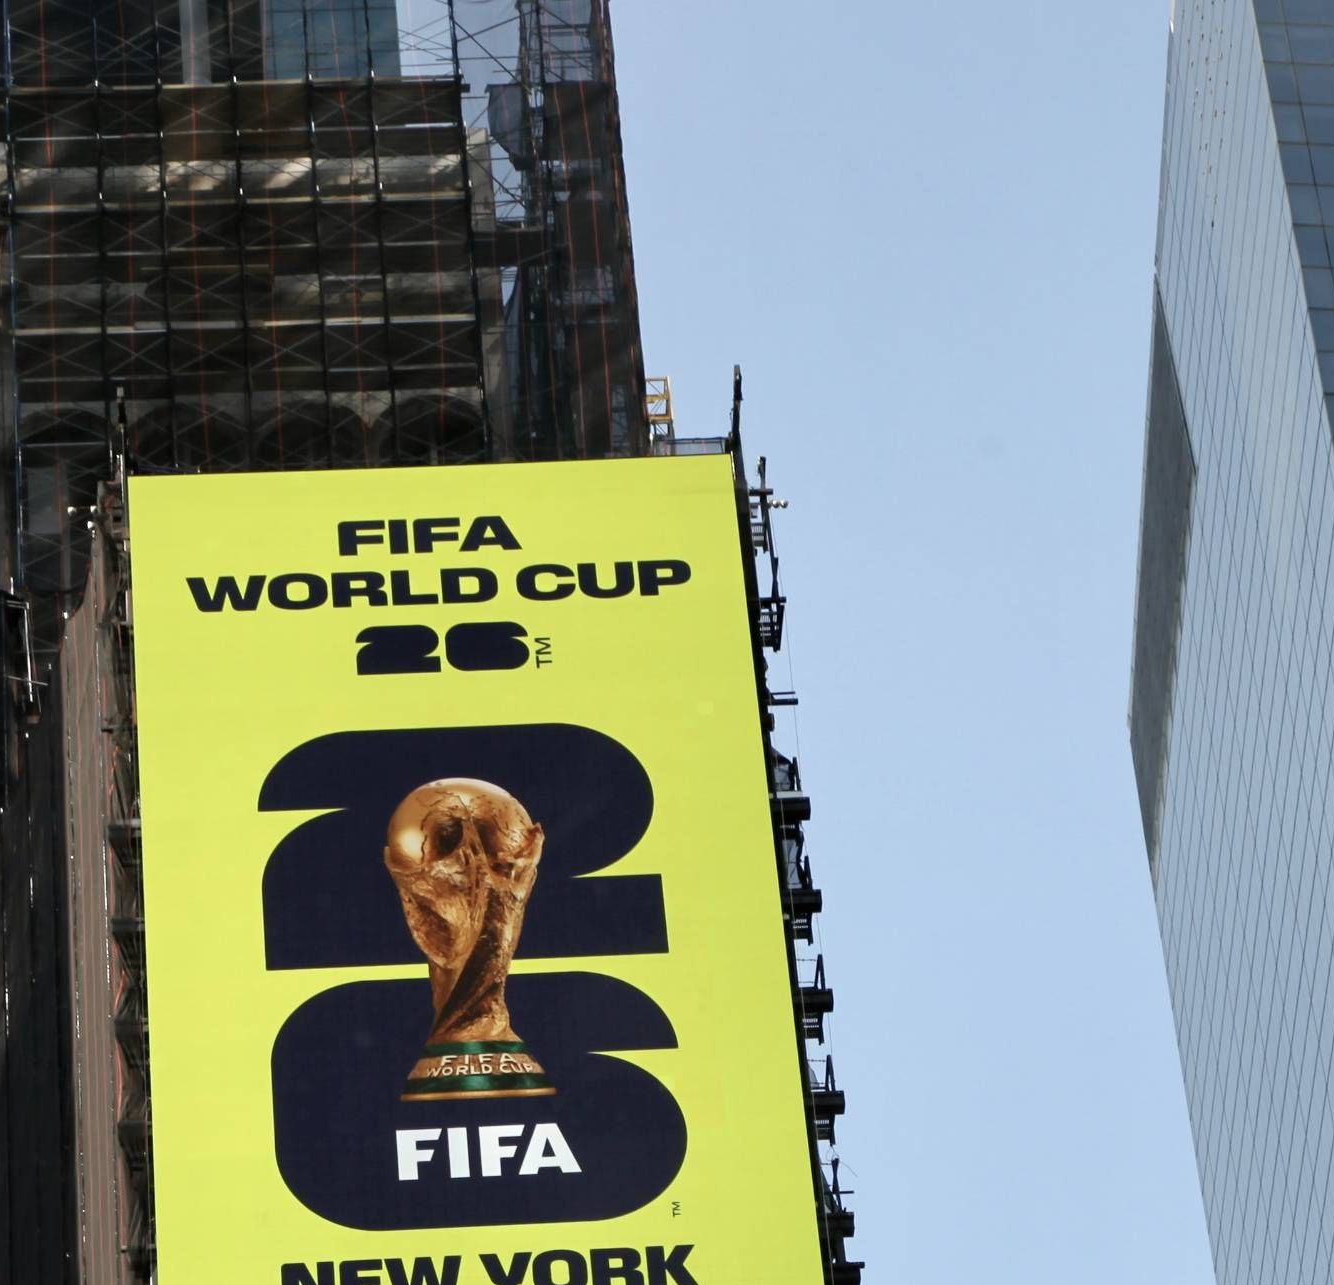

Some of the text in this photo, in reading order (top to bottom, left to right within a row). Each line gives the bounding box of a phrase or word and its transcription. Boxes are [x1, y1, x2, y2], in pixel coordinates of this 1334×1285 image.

[337, 516, 523, 557] FIFA
[186, 560, 692, 613] WORLD CUP
[355, 621, 530, 676] 26
[427, 1062, 535, 1077] WORLD CUP
[440, 1053, 517, 1067] FIFA
[395, 1122, 582, 1181] FIFA
